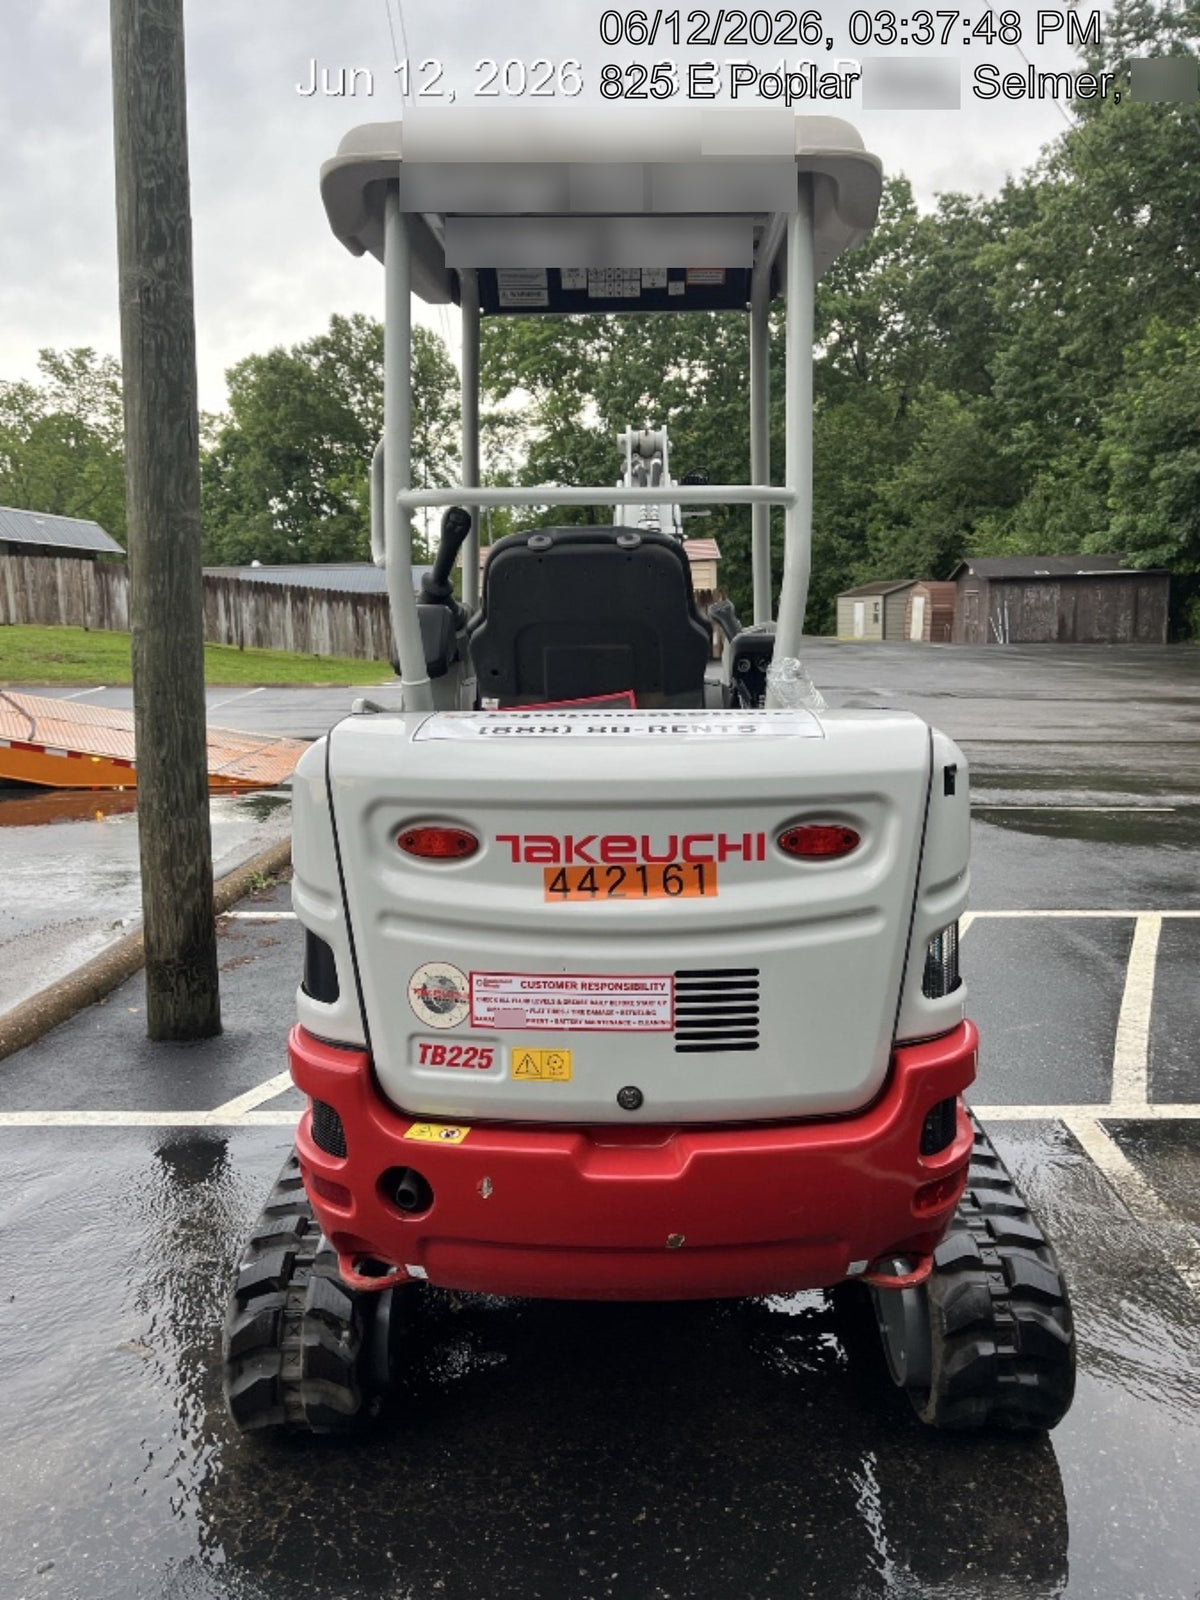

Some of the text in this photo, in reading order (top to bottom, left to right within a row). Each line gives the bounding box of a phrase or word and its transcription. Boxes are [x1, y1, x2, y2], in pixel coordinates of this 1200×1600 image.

[496, 832, 766, 863] TAKEUCHI
[548, 863, 707, 899] 442161
[520, 980, 578, 990] CUSTOMER
[581, 982, 666, 991] RESPONSIBILITY
[418, 1043, 495, 1070] TB225
